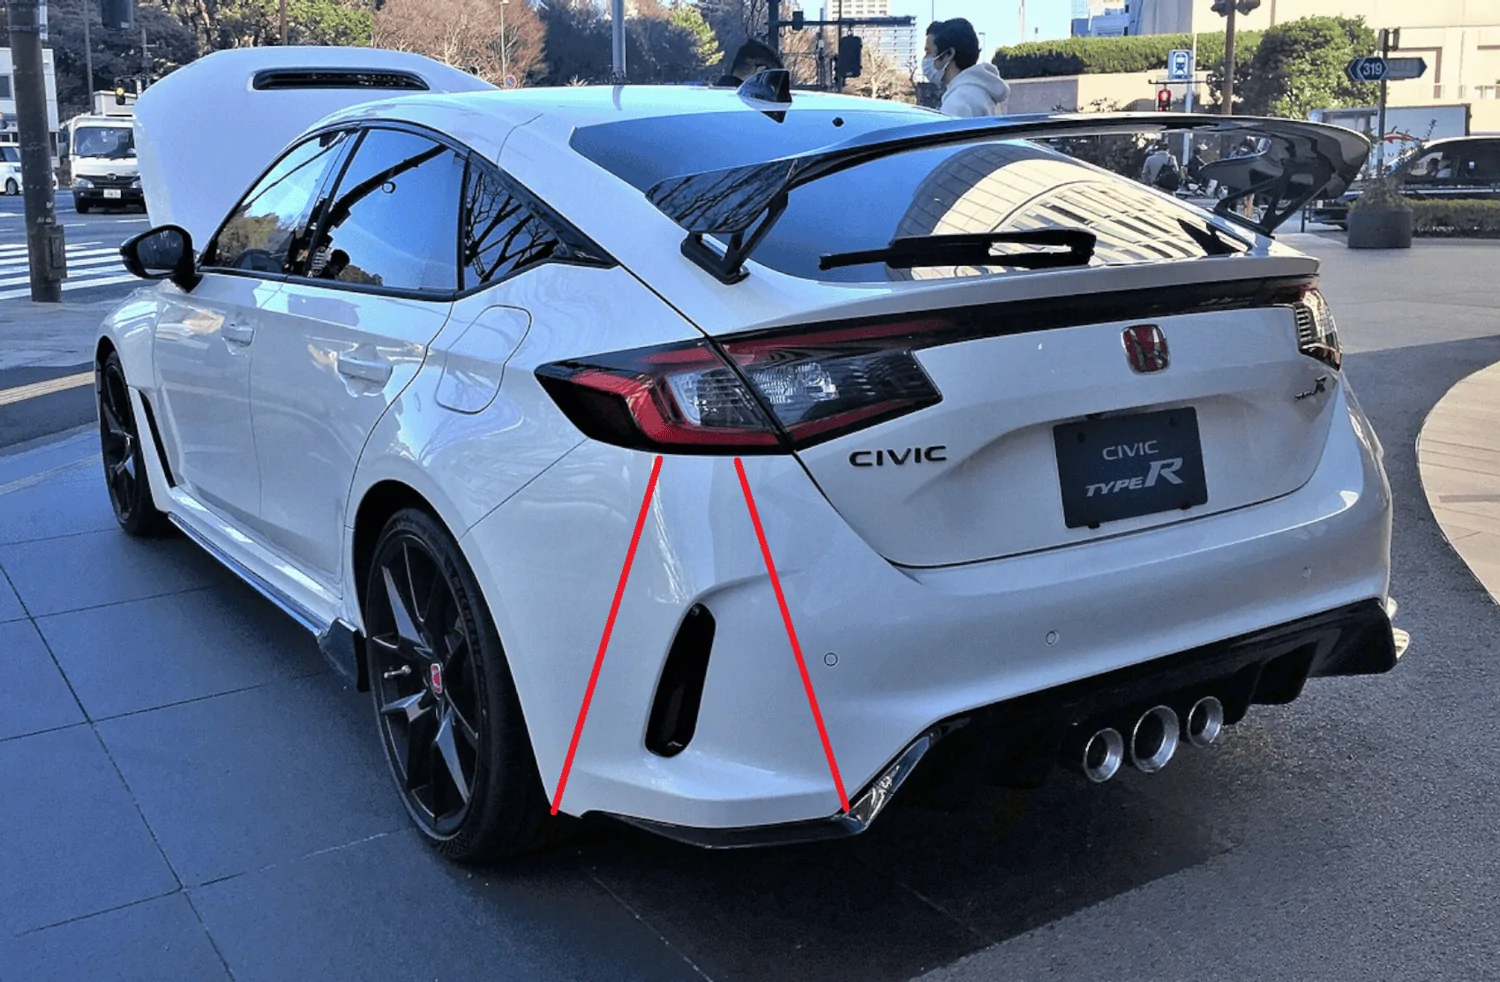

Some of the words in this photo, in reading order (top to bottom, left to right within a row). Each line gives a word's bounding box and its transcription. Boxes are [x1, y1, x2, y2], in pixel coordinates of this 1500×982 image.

[1363, 62, 1383, 76] 319
[848, 445, 948, 467] CIVIC
[1102, 440, 1160, 461] CIVIC
